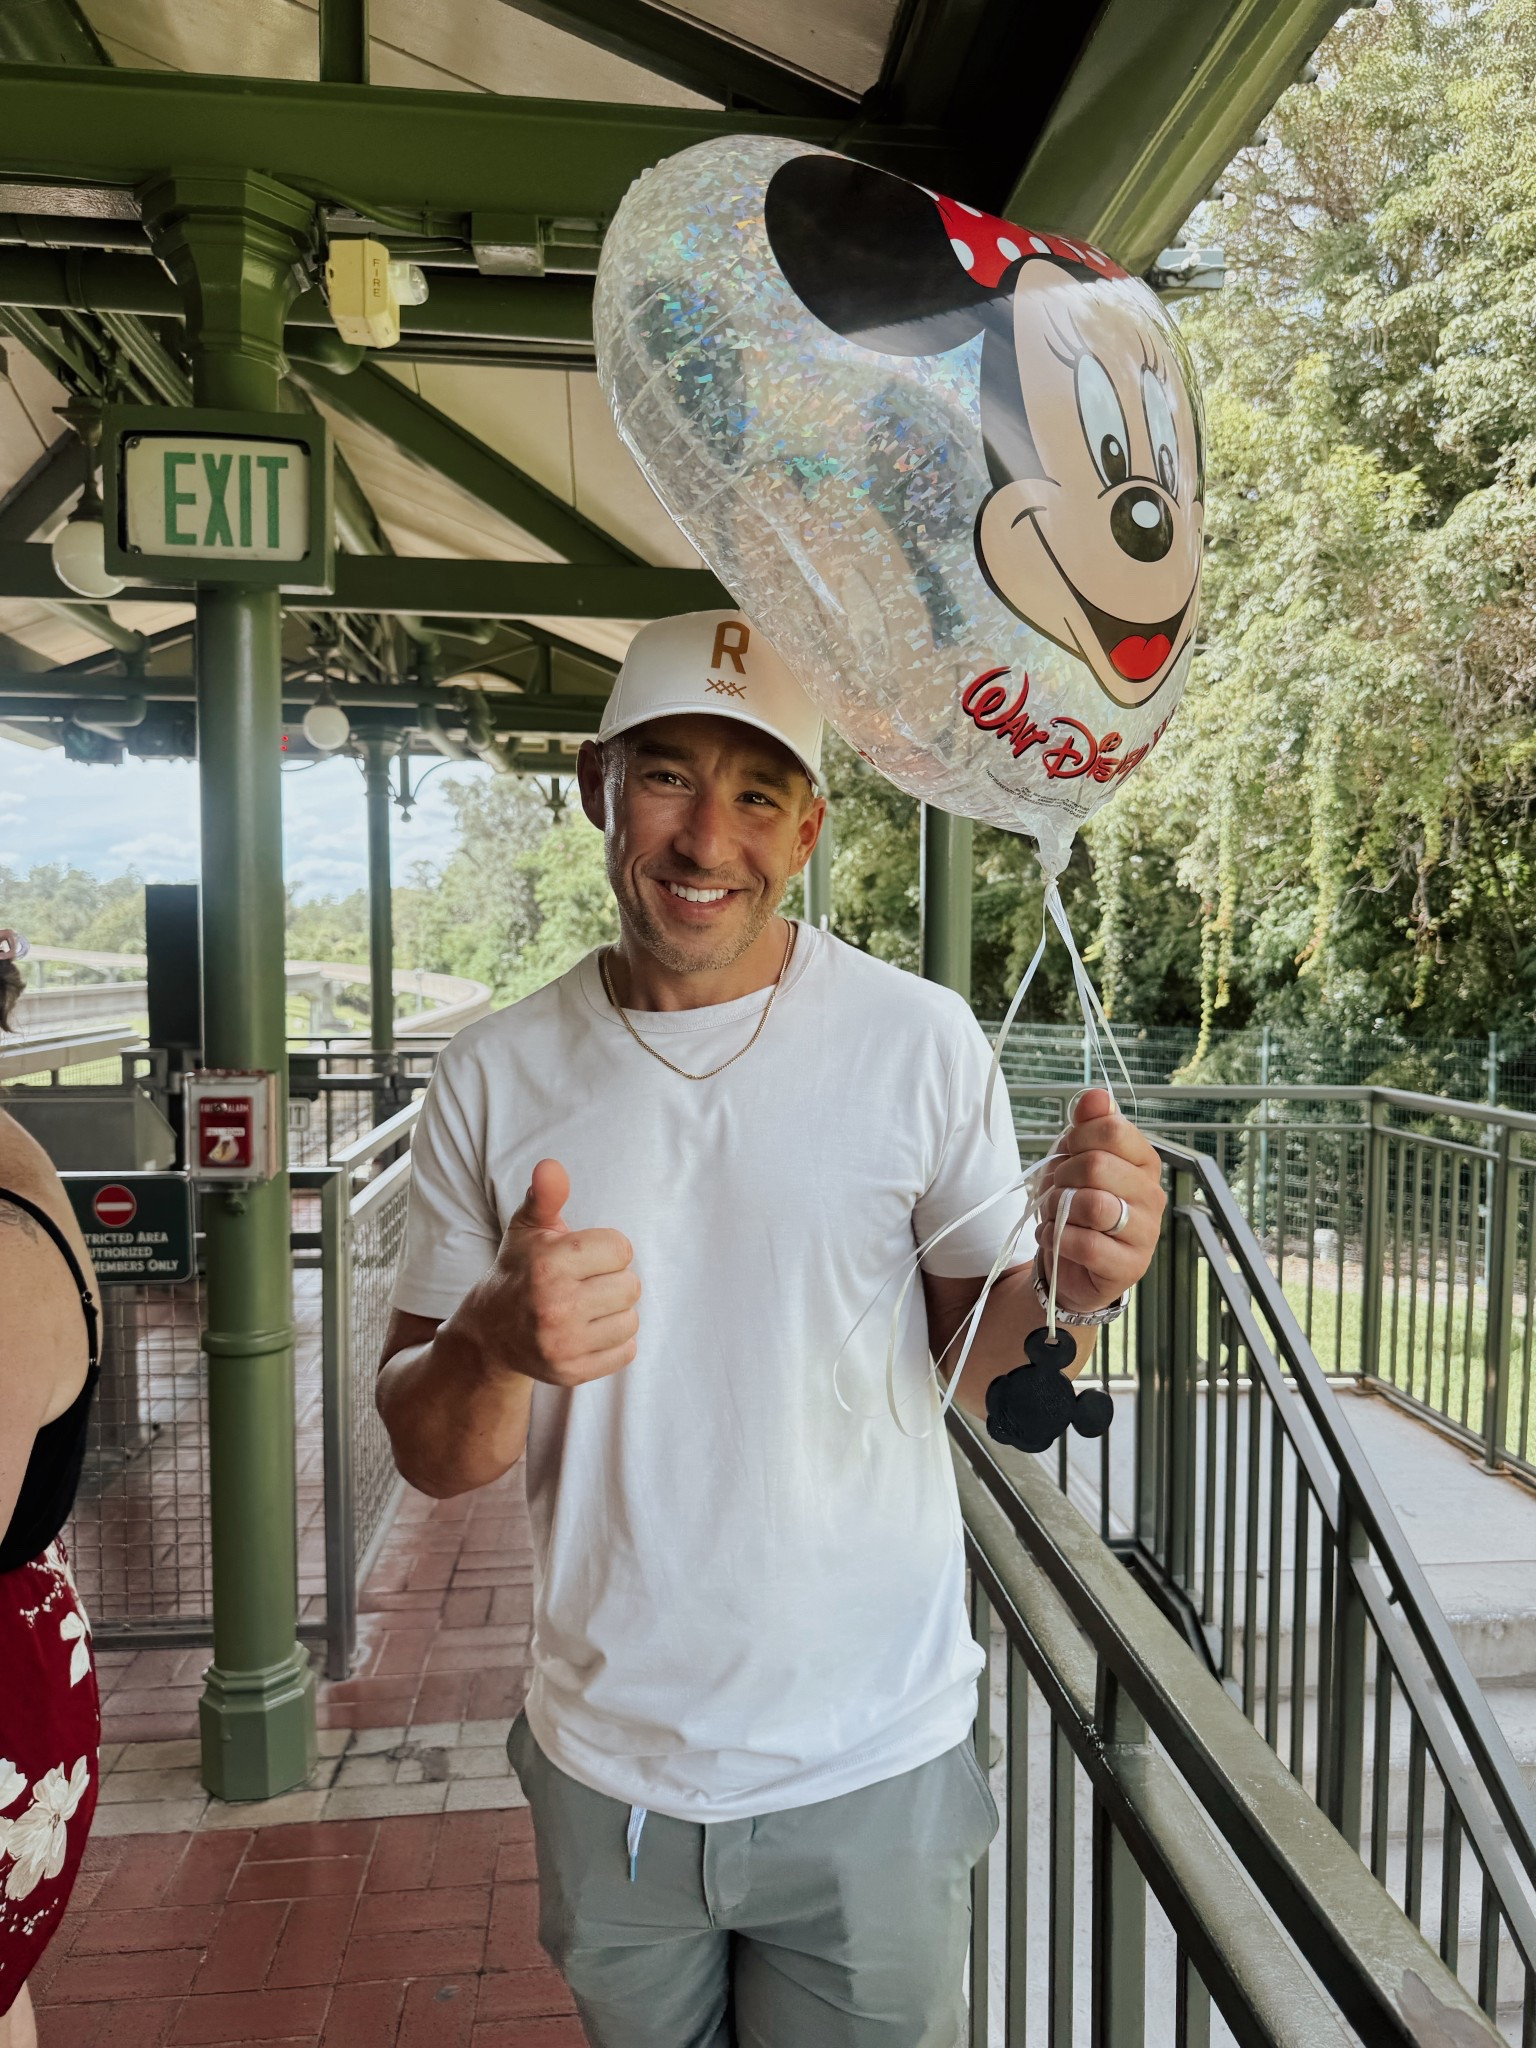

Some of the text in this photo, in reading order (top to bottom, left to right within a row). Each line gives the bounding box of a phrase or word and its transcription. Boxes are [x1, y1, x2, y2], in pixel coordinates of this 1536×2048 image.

[373, 259, 381, 297] FIRE
[163, 452, 288, 549] EXIT
[711, 620, 751, 674] R
[84, 1230, 169, 1245] TRICTED AREA
[90, 1246, 153, 1259] UTHORIZED
[146, 1259, 179, 1271] ONLY
